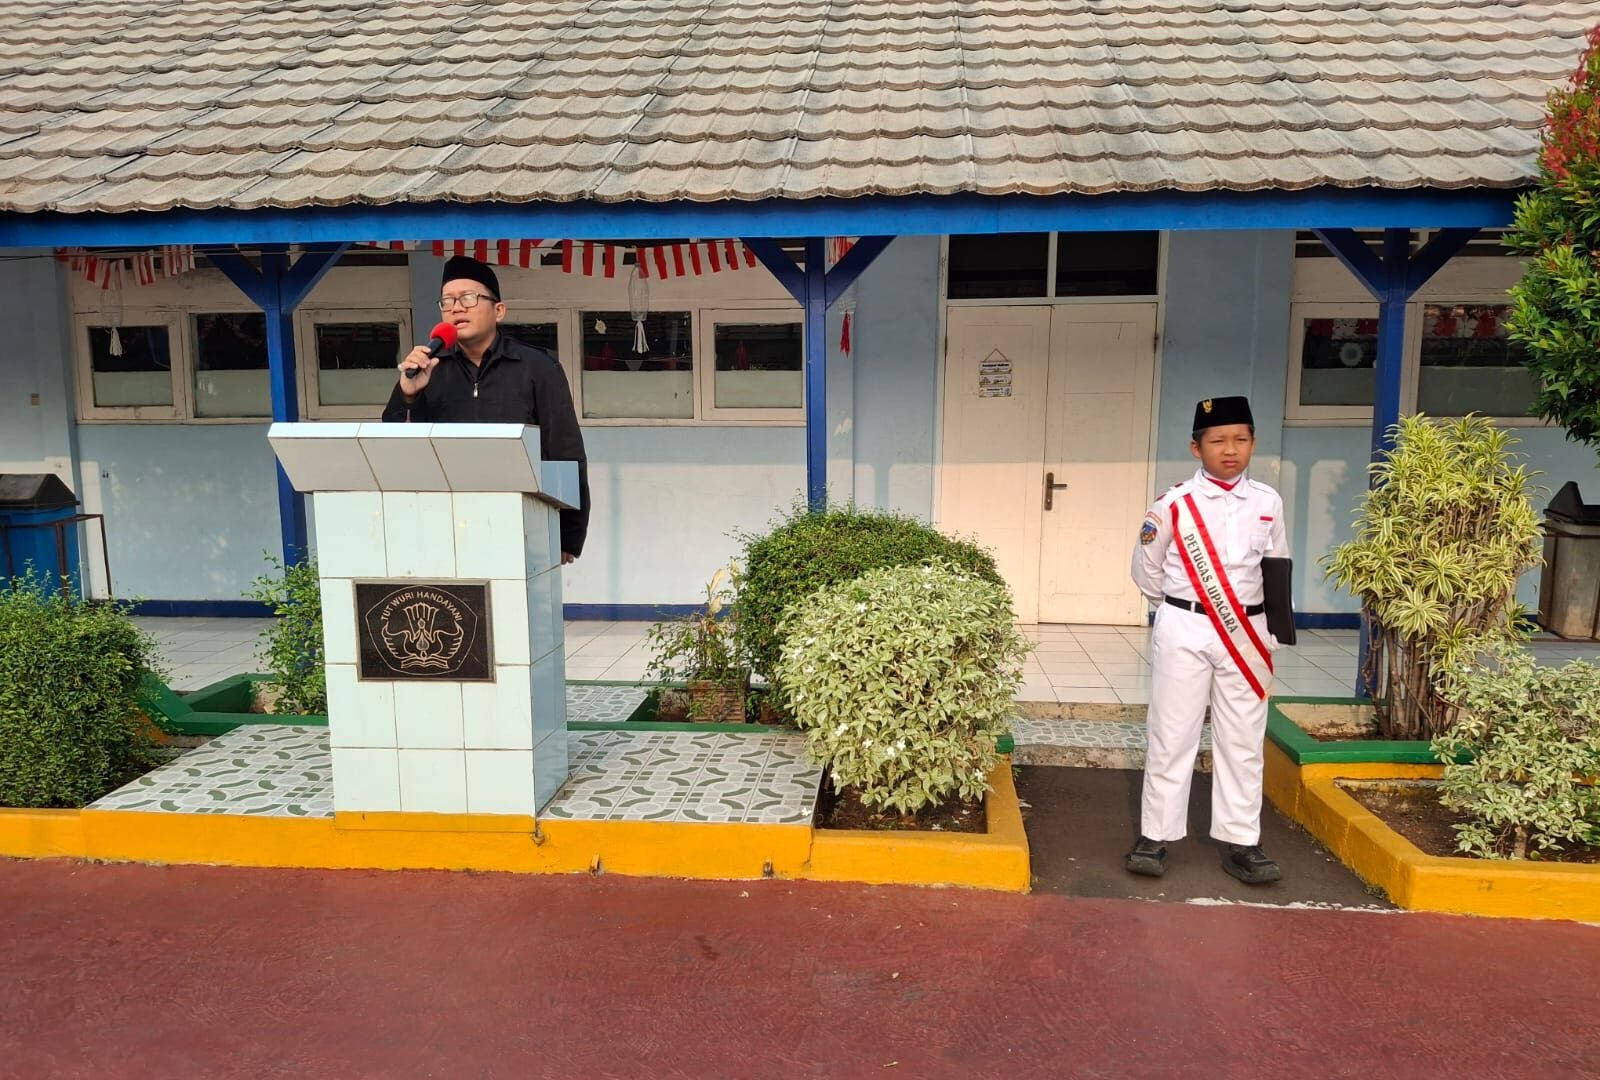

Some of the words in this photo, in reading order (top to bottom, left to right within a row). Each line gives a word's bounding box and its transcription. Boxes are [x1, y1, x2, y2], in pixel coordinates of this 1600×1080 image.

[381, 605, 394, 621] TUT
[391, 591, 414, 607] WURI
[416, 591, 463, 621] HANDAYANI
[1184, 533, 1212, 583] PETUGAS
[1207, 585, 1239, 634] UPACARA
